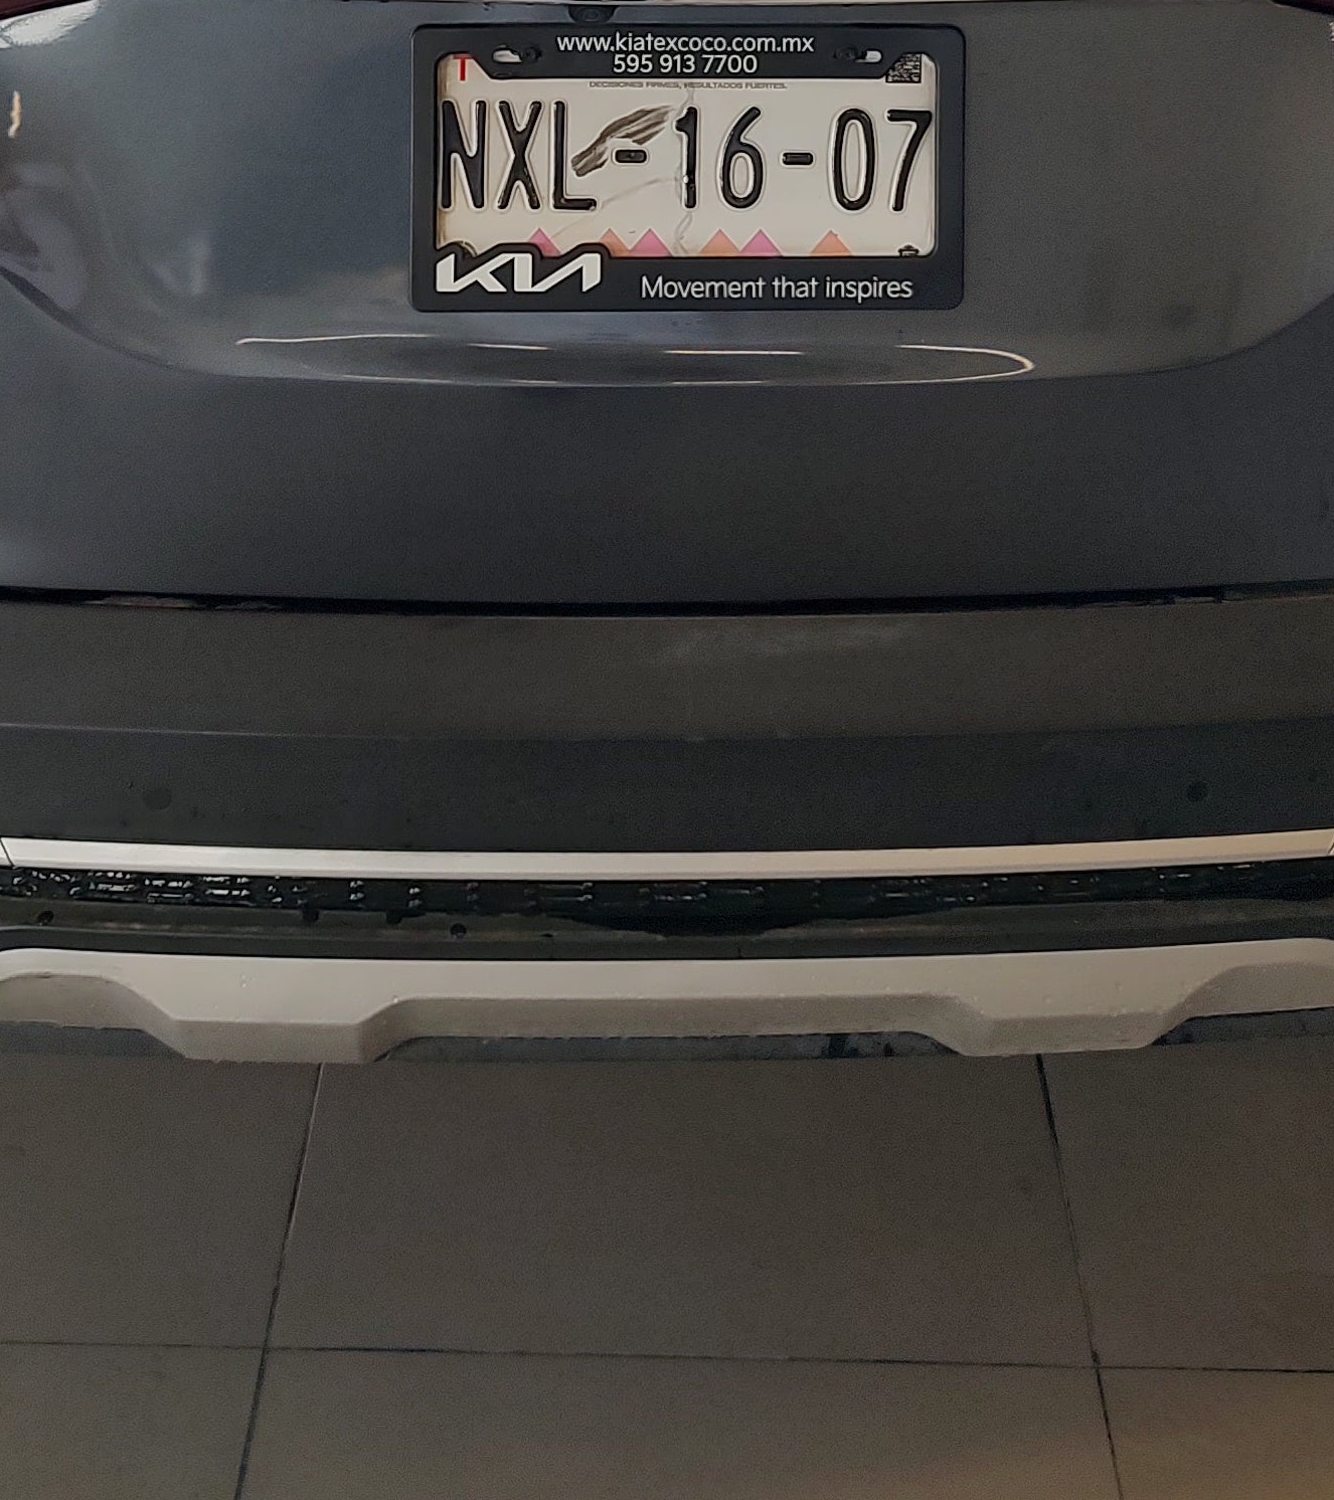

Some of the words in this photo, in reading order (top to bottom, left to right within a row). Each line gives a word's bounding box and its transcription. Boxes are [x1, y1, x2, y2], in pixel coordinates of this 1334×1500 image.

[556, 31, 815, 53] www.kiatexcoco.com.mx
[613, 54, 653, 74] 595
[659, 54, 697, 74] 913
[702, 54, 758, 74] 7700
[440, 100, 933, 212] NXL-16-07
[436, 252, 602, 293] KIA
[640, 277, 766, 300] Movement
[771, 277, 818, 300] that
[824, 277, 913, 303] inspires
